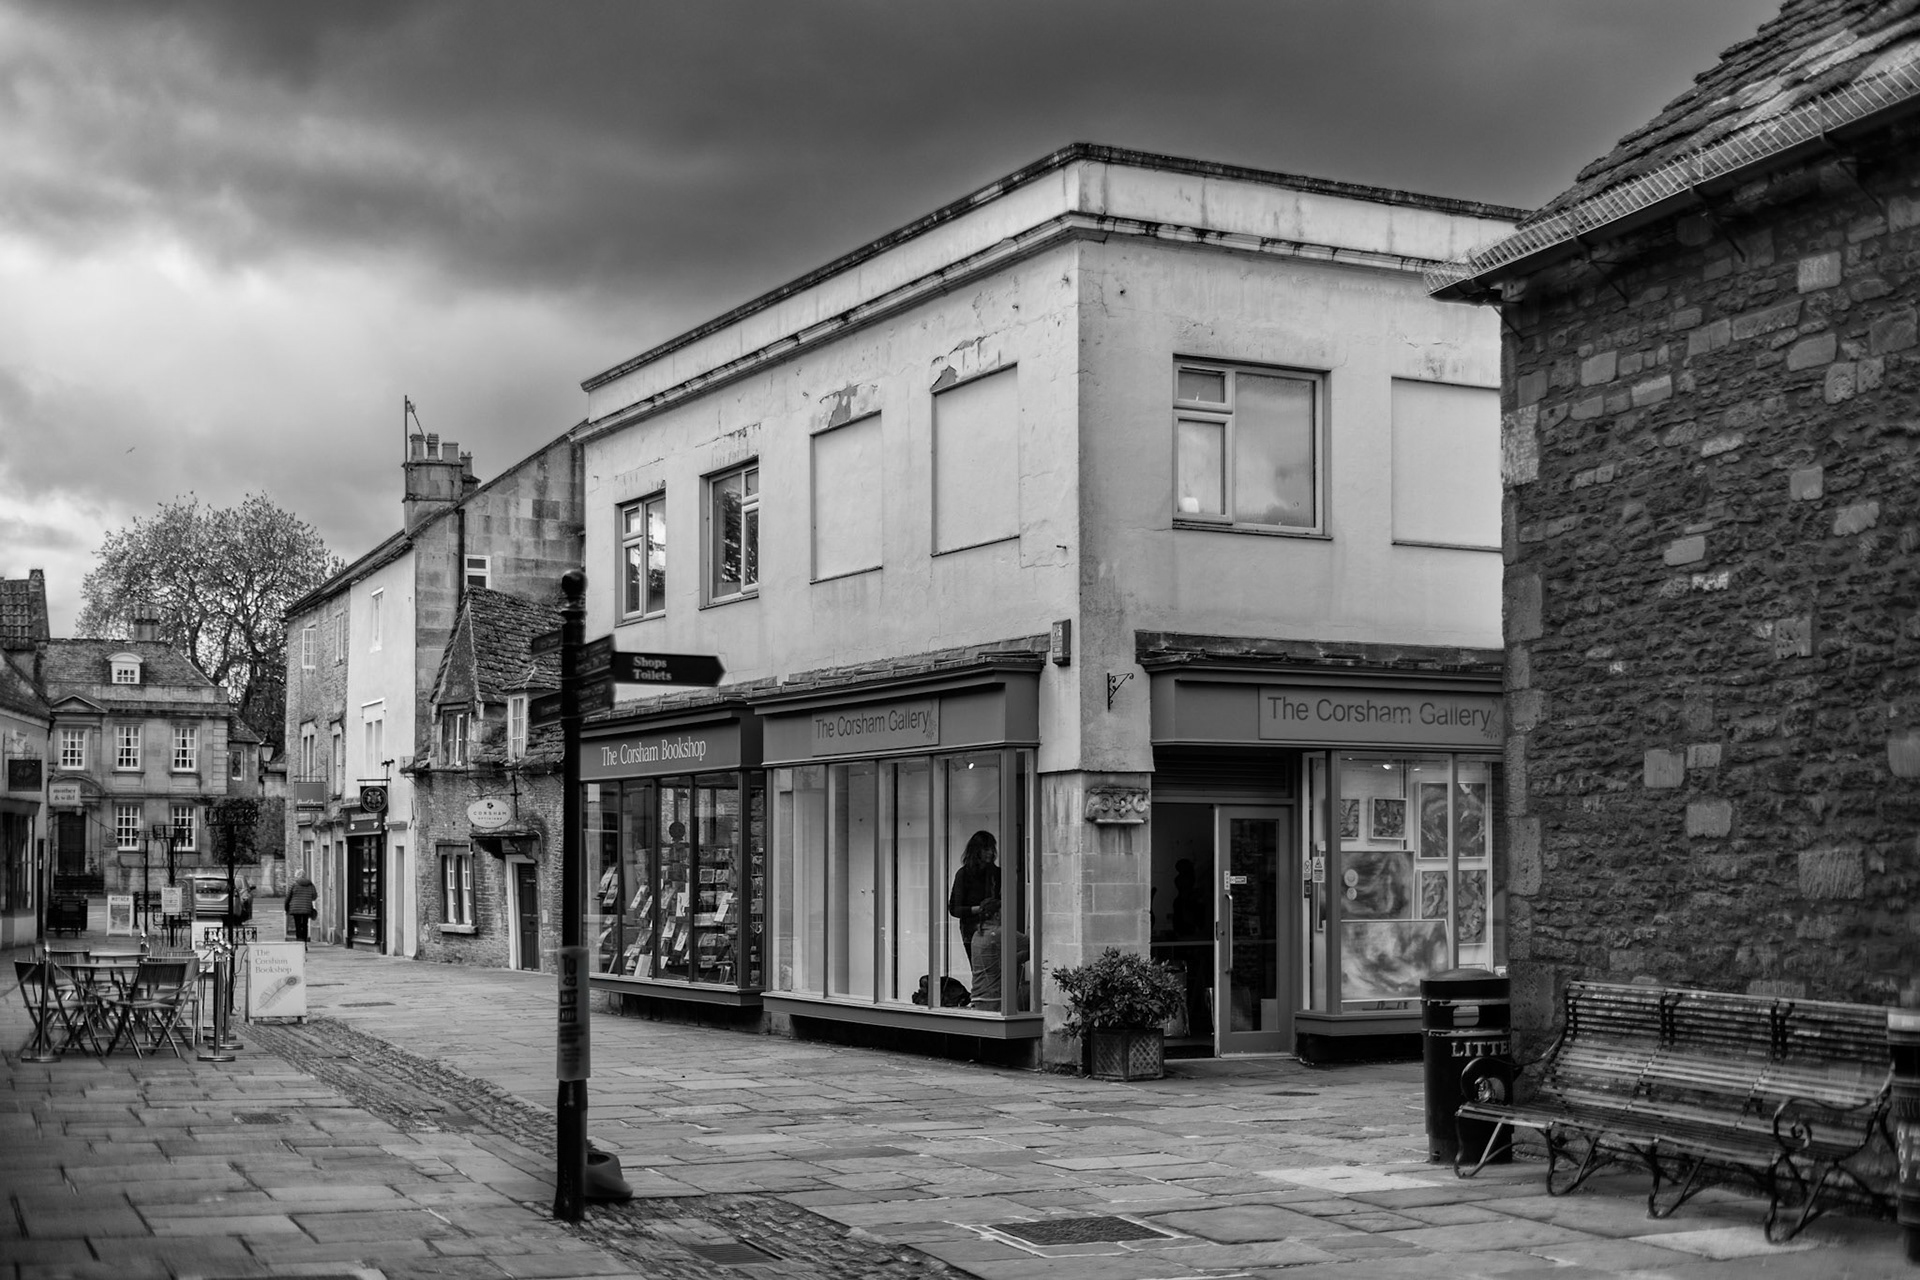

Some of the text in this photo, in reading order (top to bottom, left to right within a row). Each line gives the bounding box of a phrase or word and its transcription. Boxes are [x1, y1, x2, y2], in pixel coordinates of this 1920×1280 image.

[633, 656, 667, 669] Shops
[633, 668, 672, 681] Toilets
[1267, 696, 1492, 731] The Corsham Gallery
[815, 706, 930, 739] The Corsham Gallery
[601, 736, 707, 767] The Corsham Bookshop
[255, 949, 270, 957] The
[255, 957, 289, 965] Corsham
[255, 965, 293, 975] Bookshop
[1451, 1040, 1511, 1058] LITTE
